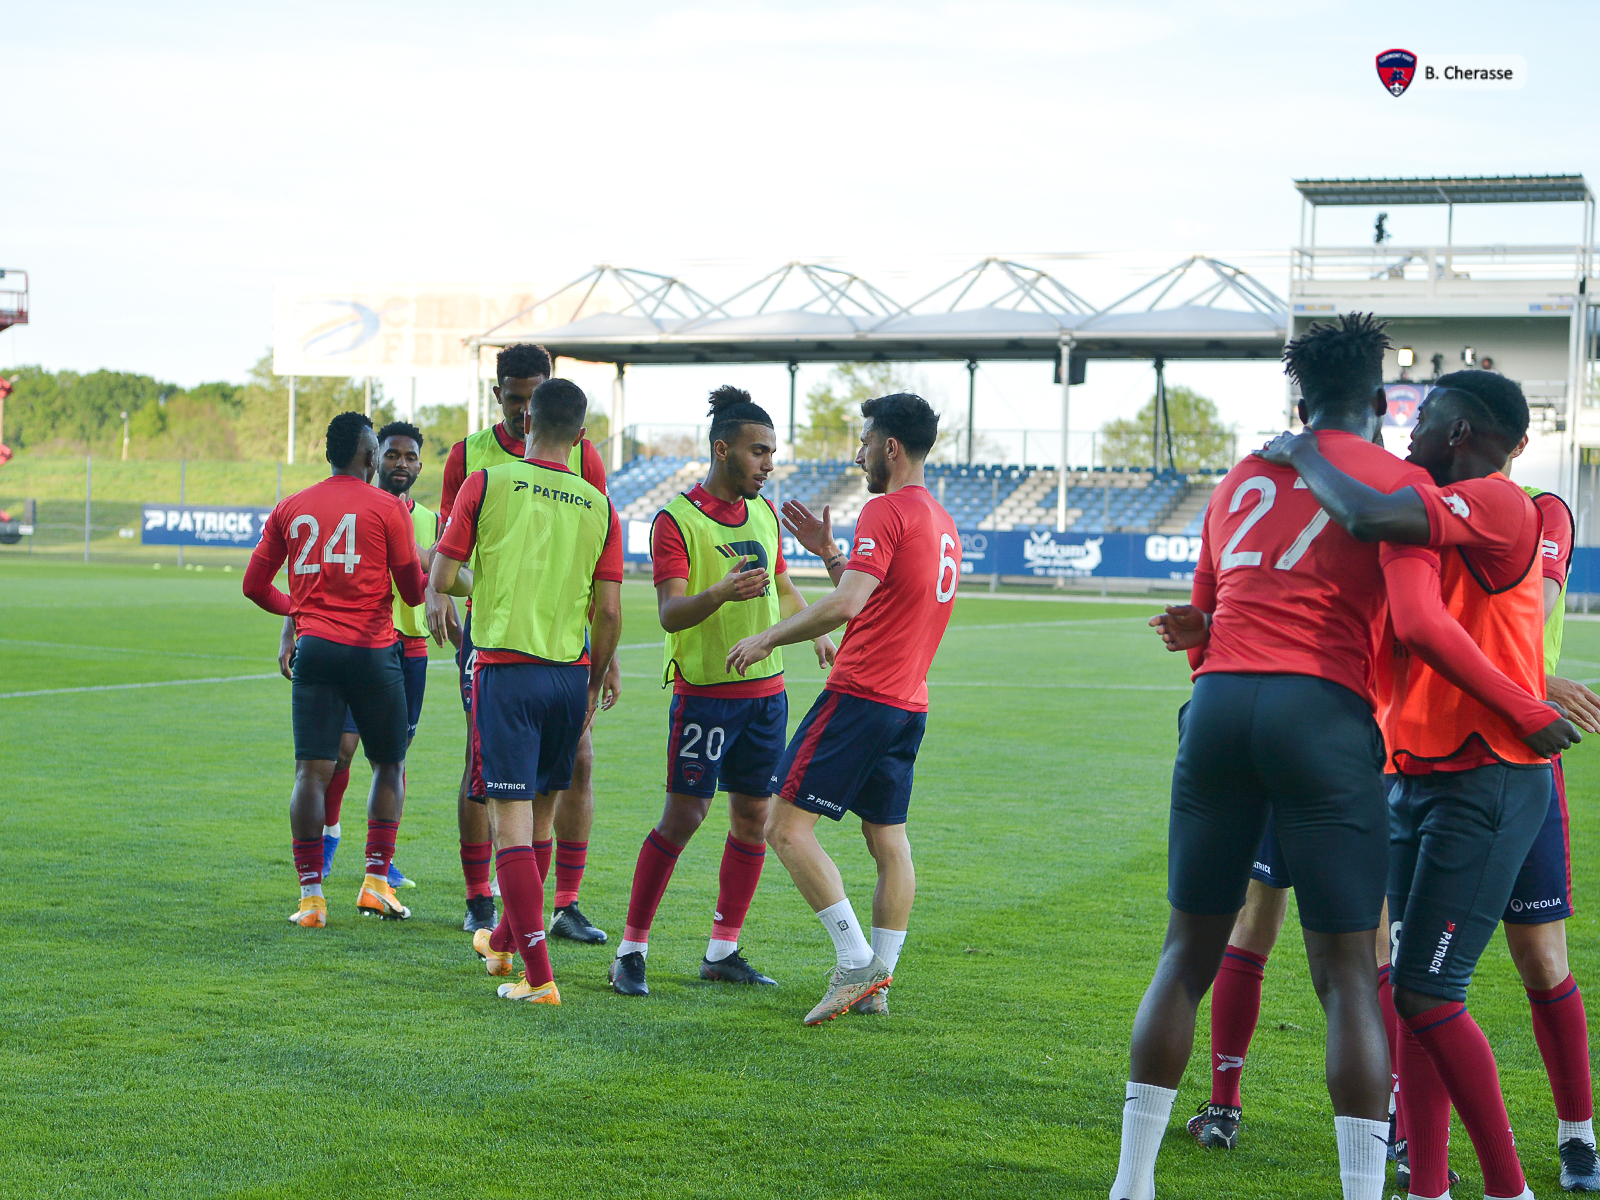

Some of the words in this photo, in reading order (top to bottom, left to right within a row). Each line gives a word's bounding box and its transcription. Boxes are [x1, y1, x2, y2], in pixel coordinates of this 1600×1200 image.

[533, 484, 592, 509] PATRICK
[166, 510, 254, 532] PATRICK
[1221, 476, 1331, 571] 27
[290, 513, 362, 575] 24
[936, 533, 957, 603] 6
[680, 723, 725, 761] 20
[494, 782, 526, 790] PATRICK
[815, 797, 843, 812] PATRICK
[1525, 897, 1562, 910] VEOLIA
[1429, 931, 1453, 974] PATRICK
